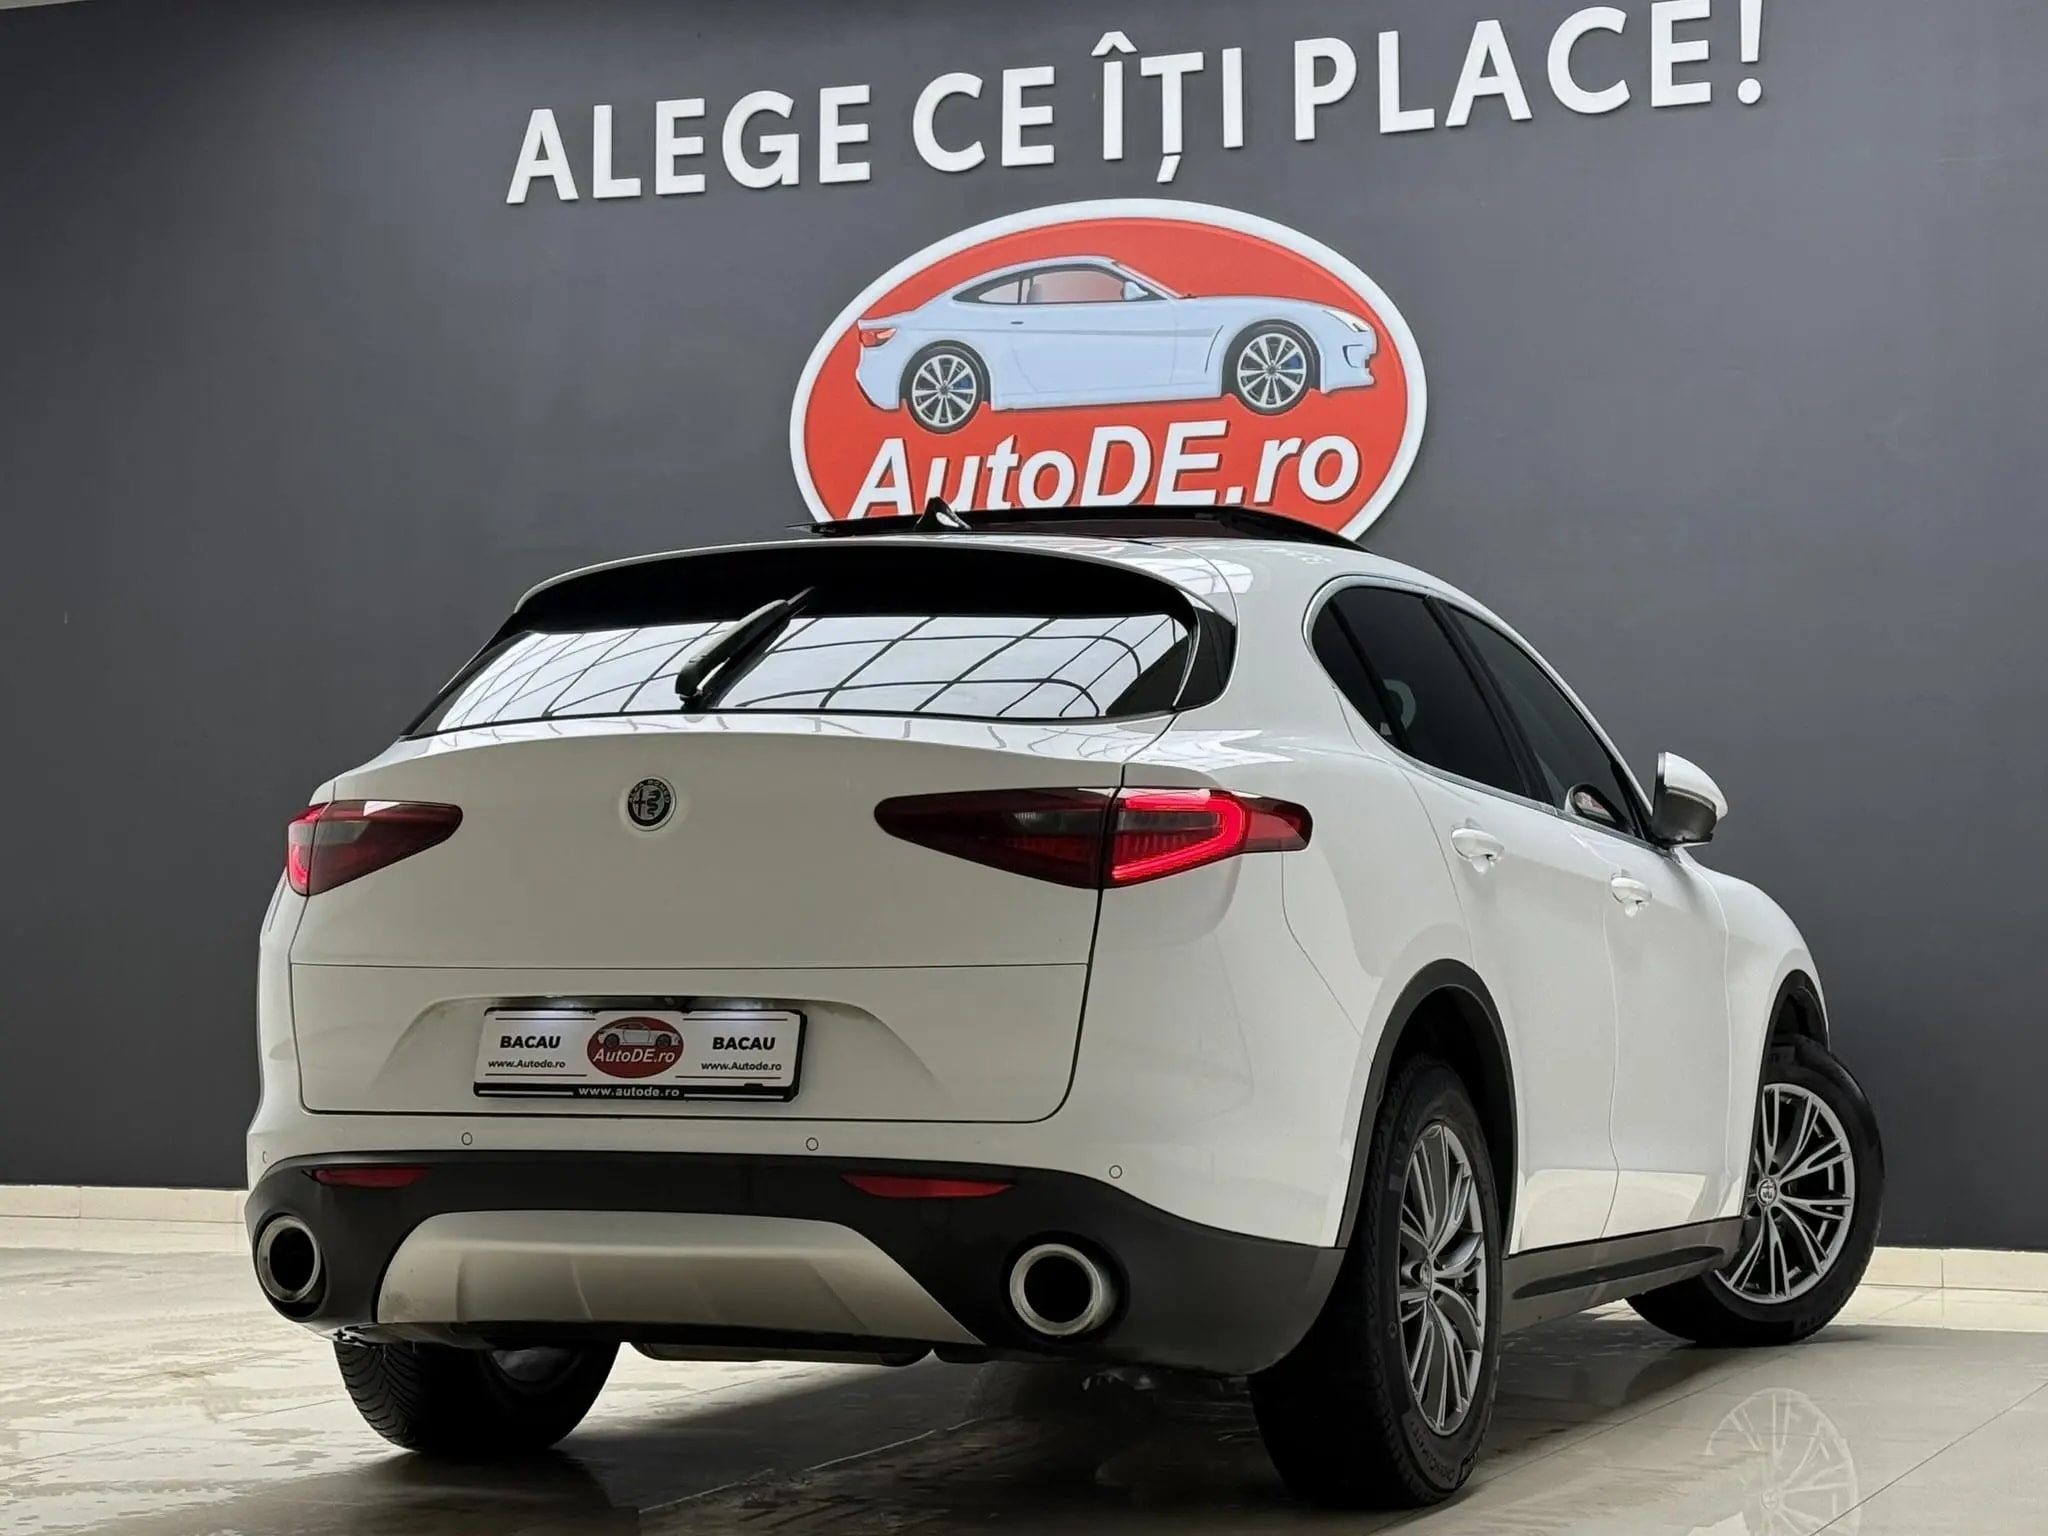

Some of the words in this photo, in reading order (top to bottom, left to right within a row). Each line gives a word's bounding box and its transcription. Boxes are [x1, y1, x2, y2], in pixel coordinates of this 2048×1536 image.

[506, 84, 870, 204] ALEGE
[912, 65, 1055, 172] CE
[1091, 31, 1243, 183] ÎȚI
[1294, 0, 1763, 141] PLACE!
[847, 420, 1360, 520] AutoDE.ro
[499, 1035, 562, 1049] BACAU
[712, 1036, 776, 1051] BACAU
[592, 1048, 676, 1064] AutoDE.ro
[700, 1061, 782, 1072] www.Autode.ro
[578, 1086, 680, 1097] www.autode.ro
